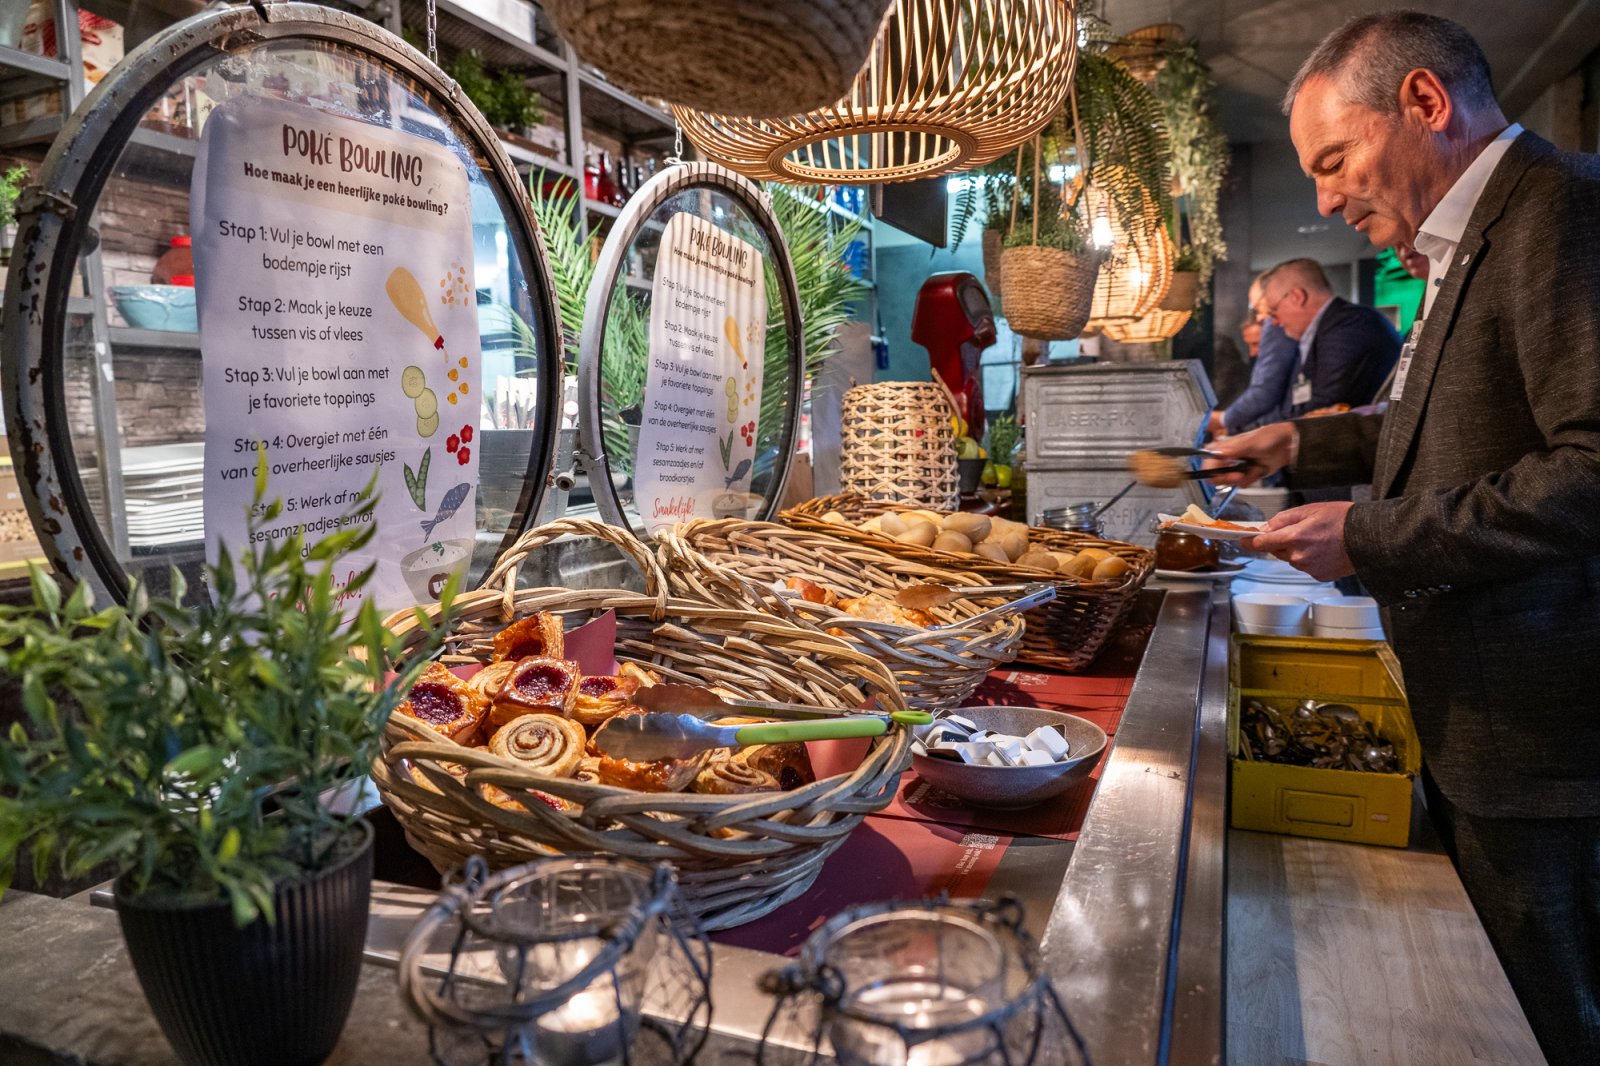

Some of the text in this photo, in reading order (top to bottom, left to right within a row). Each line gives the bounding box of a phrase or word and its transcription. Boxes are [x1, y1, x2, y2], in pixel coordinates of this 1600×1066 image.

[283, 124, 422, 186] POKÉ BOWLING
[244, 162, 448, 215] Hoe maak je een heerlijke poké bowling?
[219, 221, 384, 256] Stap 1: Vul je bowl met een
[712, 237, 748, 269] BOWLING
[263, 253, 352, 279] bodempje rijst
[238, 296, 373, 319] Stap 2: Maak je keuze
[252, 326, 363, 341] tussen vis of vlees
[225, 366, 389, 386] Stap 3: Vul je bowl aan met
[655, 359, 669, 372] Stap
[248, 391, 375, 414] je favoriete toppings
[654, 400, 667, 413] Stap
[648, 417, 658, 425] van
[659, 417, 667, 426] de
[273, 435, 283, 449] 4:
[287, 431, 340, 449] Overgiet
[343, 429, 365, 443] met
[368, 426, 388, 440] één
[656, 441, 669, 453] Stap
[221, 467, 247, 480] van
[273, 453, 352, 475] overheerlijke
[356, 449, 395, 466] sausjes
[287, 498, 298, 511] 5:
[300, 492, 331, 509] Werk
[334, 489, 347, 504] af
